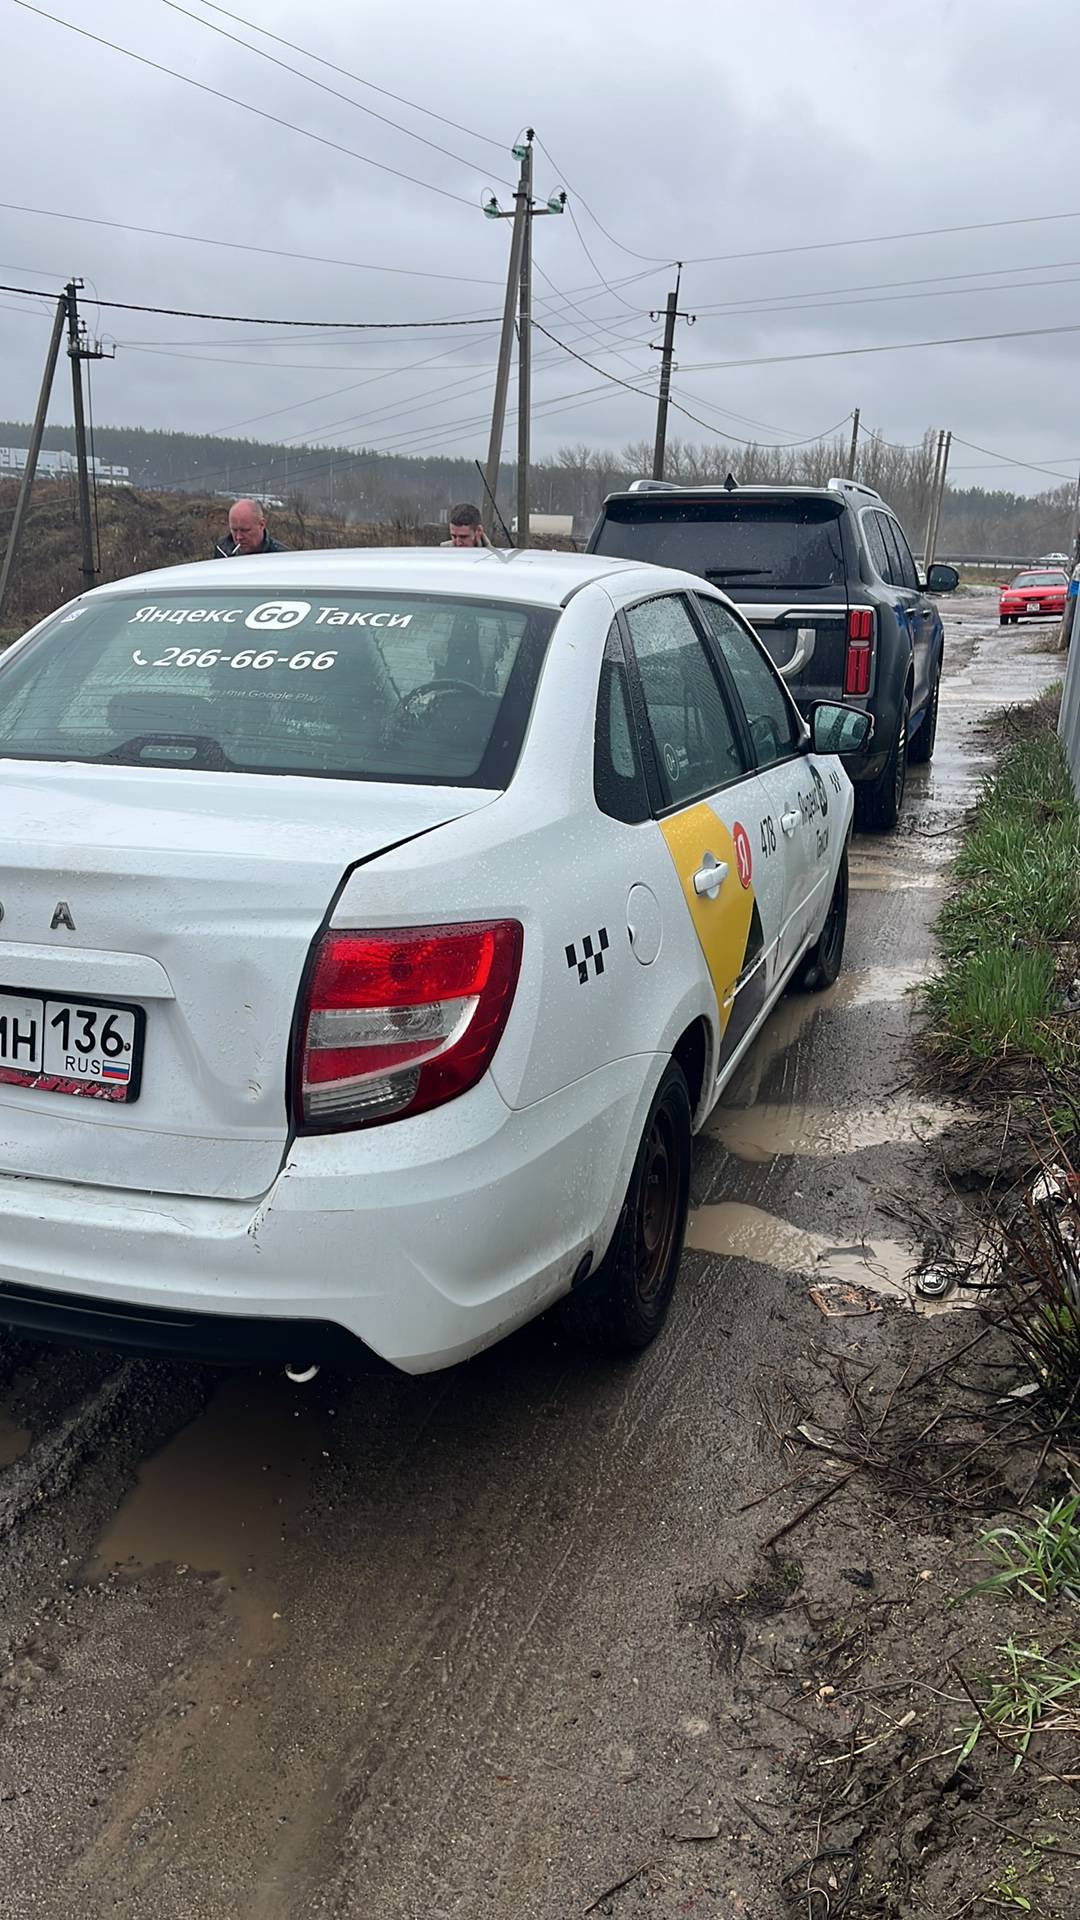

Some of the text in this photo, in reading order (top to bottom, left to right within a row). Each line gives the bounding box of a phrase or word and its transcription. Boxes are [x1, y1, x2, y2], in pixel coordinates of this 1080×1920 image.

[128, 605, 413, 628] Яндекс Go Такси
[152, 647, 338, 670] 266-66-66
[248, 689, 293, 701] Google
[295, 692, 322, 703] Play
[760, 815, 777, 859] 478
[51, 1008, 123, 1057] 136
[65, 1055, 101, 1075] RUS
